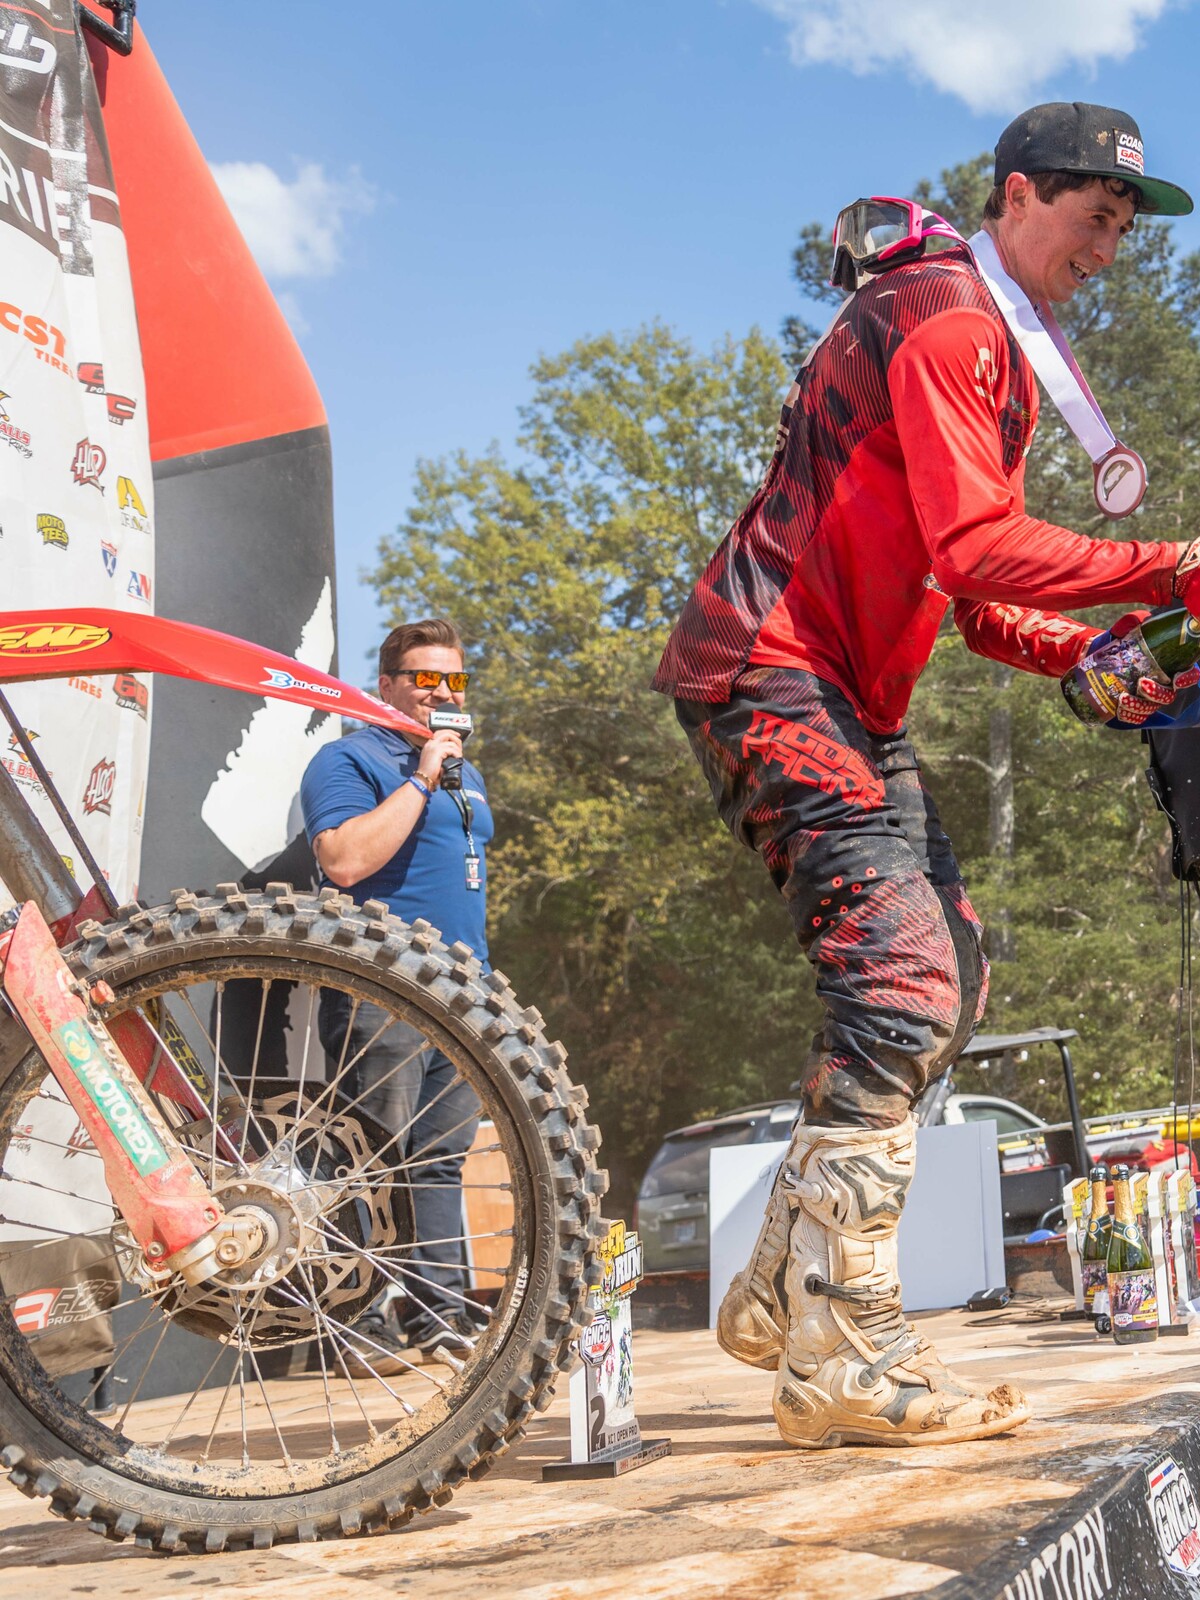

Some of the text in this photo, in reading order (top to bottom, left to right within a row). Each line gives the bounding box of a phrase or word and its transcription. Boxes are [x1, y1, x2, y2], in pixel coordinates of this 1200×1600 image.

[1119, 133, 1143, 153] COAS
[1121, 149, 1144, 165] GAS
[0, 421, 31, 446] ALLS
[37, 514, 65, 530] MOTO
[43, 528, 68, 545] TEES
[0, 625, 109, 650] FMF
[67, 676, 103, 699] TIRES
[292, 680, 341, 698] BI-CON
[742, 734, 884, 810] RACING
[78, 1055, 161, 1165] MOTOREX
[614, 1245, 641, 1290] RUN
[617, 1429, 628, 1441] OPEN
[629, 1425, 638, 1437] PRO
[1154, 1473, 1198, 1556] GNCC
[1003, 1506, 1112, 1600] CTORY
